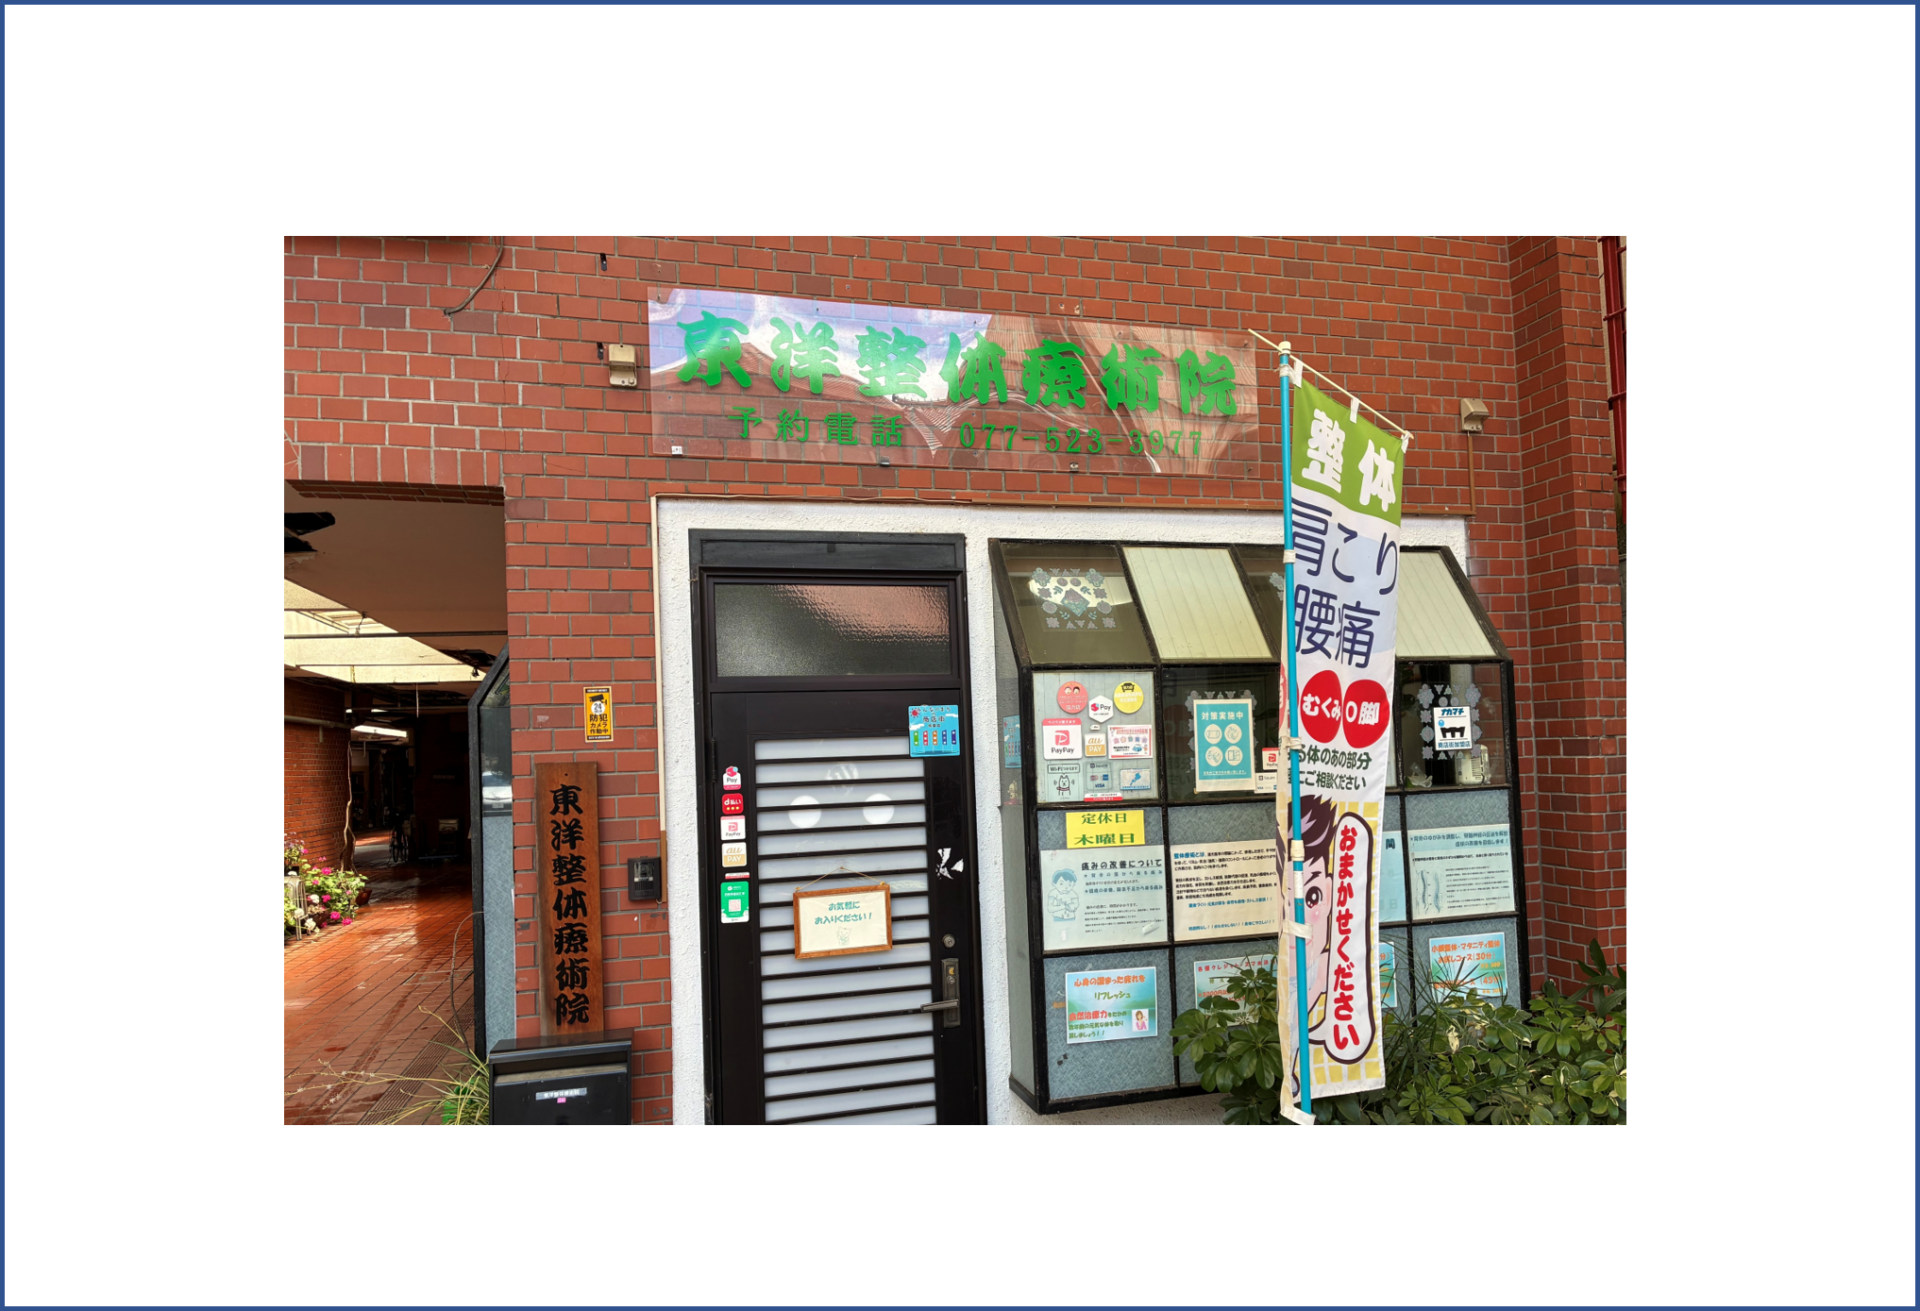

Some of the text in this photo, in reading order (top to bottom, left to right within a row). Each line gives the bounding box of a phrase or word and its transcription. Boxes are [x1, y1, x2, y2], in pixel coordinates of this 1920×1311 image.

[676, 310, 1237, 417] 東洋整体療術院
[728, 405, 1203, 457] 予約電話 077-523-3977
[1301, 408, 1396, 513] 整体
[1291, 497, 1398, 596] 肩こり
[1294, 583, 1381, 669] 腰痛
[1100, 703, 1112, 712] Pay
[1301, 693, 1342, 721] むくみ
[589, 713, 608, 722] 防犯
[1201, 711, 1244, 721] 対策実施中
[1437, 740, 1471, 749] 商店街加盟店
[1081, 812, 1128, 825] 定休日
[1074, 833, 1135, 846] 木曜日
[727, 855, 742, 863] PAY
[1081, 859, 1163, 871] 痛みの改善について
[549, 783, 590, 1027] 東洋整体療術院
[828, 901, 861, 911] お気軽に
[1333, 824, 1360, 1050] おまかせください
[1094, 991, 1131, 1000] リフレッシュ
